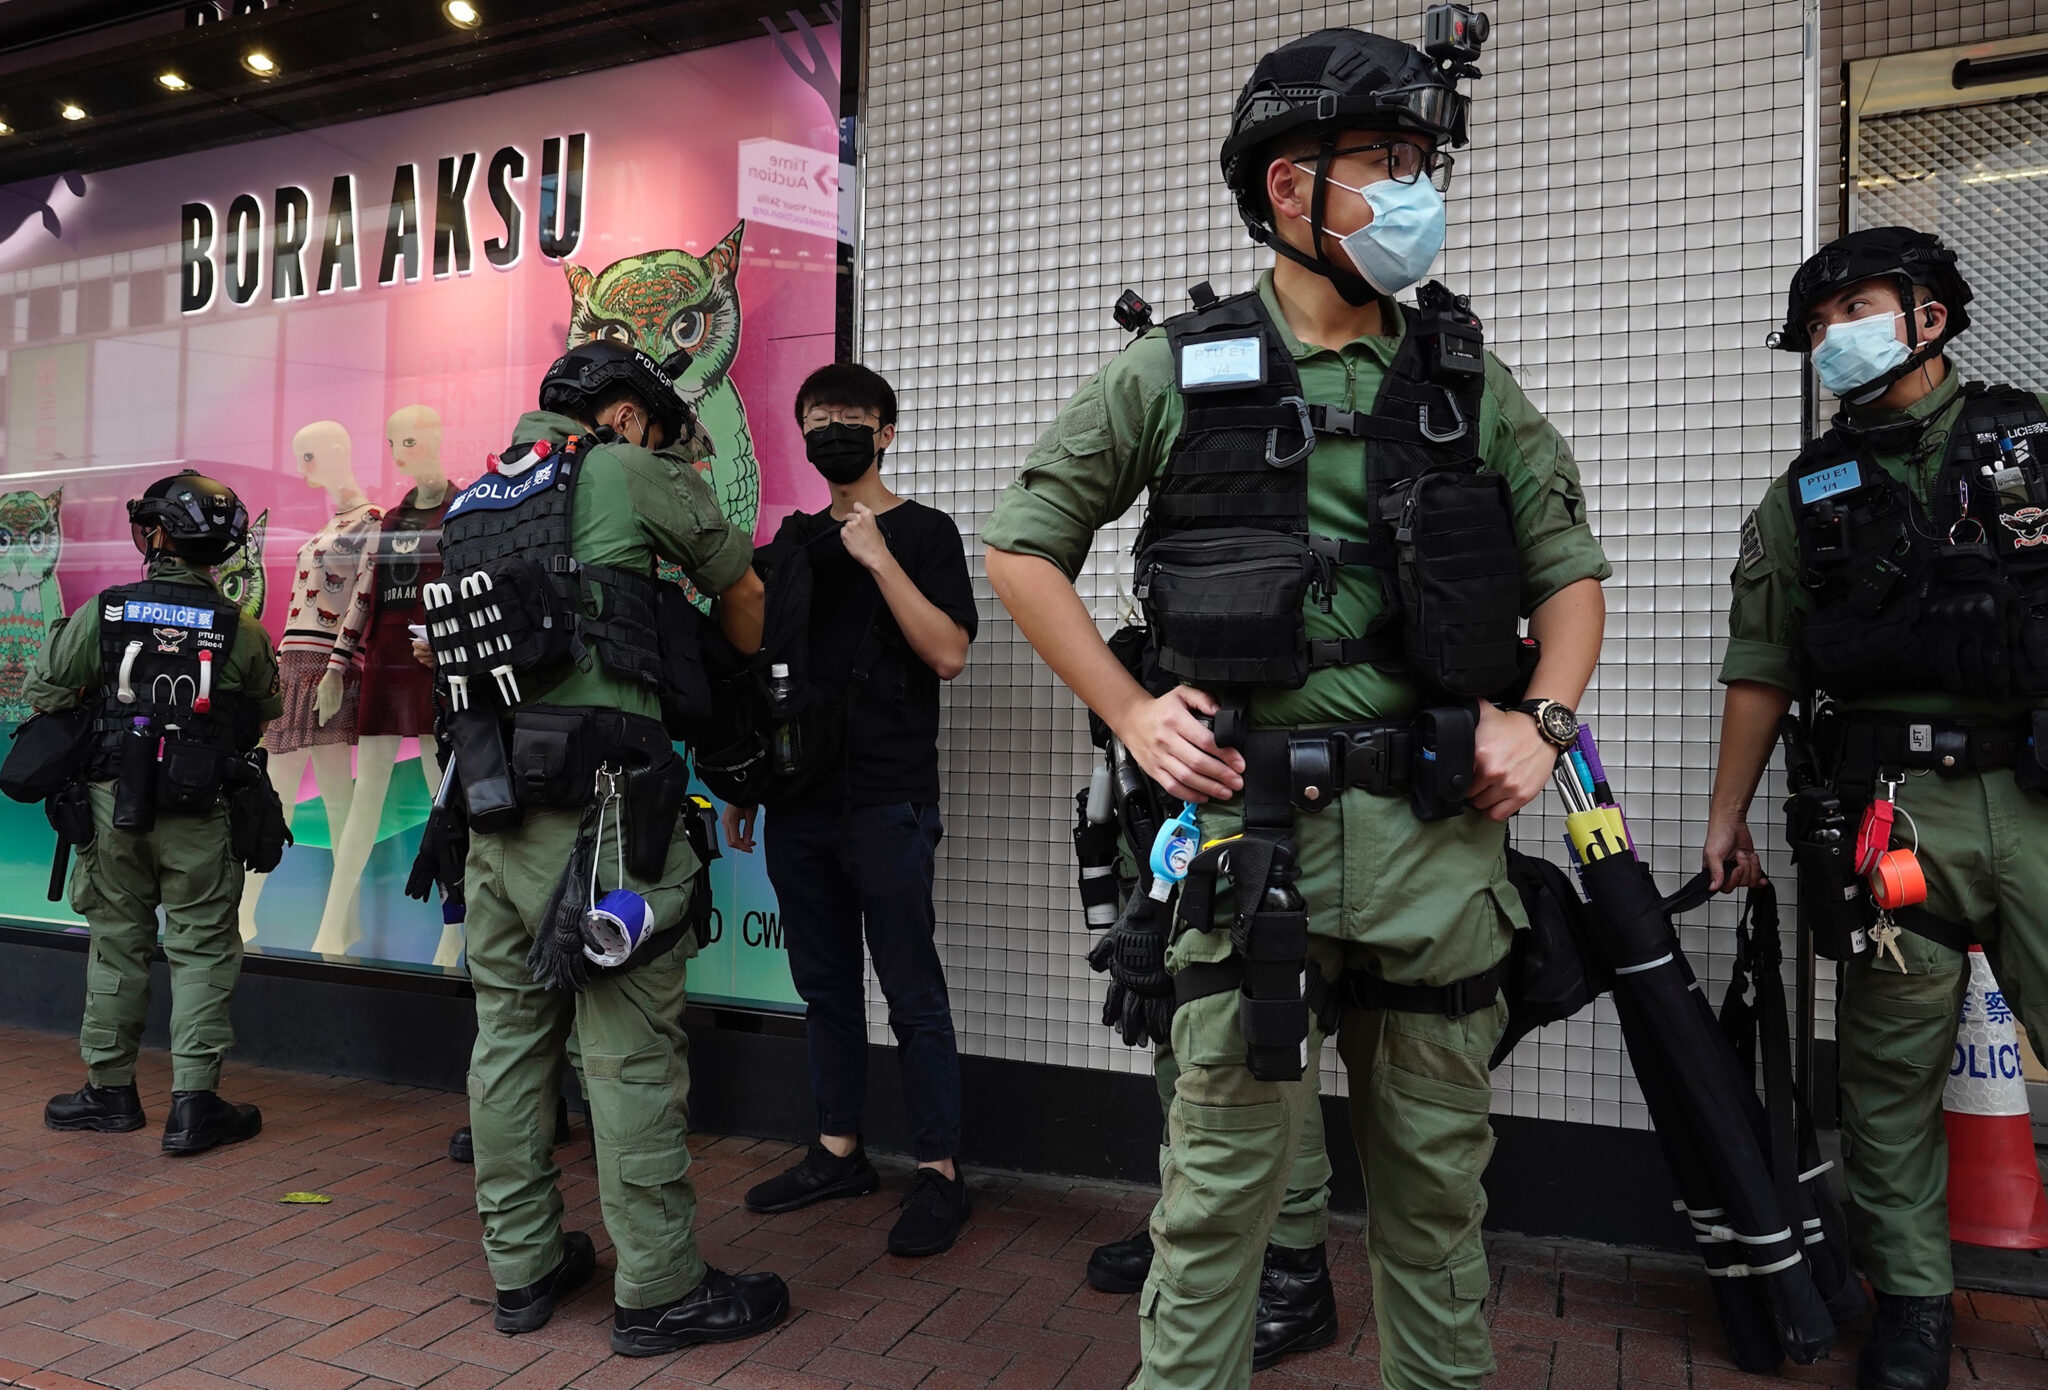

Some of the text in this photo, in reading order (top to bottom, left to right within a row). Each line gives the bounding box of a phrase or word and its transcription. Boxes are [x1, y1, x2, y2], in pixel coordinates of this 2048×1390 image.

[181, 133, 588, 315] BORA AKSU
[1194, 347, 1246, 361] PTU E1
[1807, 467, 1848, 486] PTU E1
[465, 476, 534, 502] POLICE
[1821, 482, 1837, 492] 1/1
[142, 606, 195, 624] POLICE
[198, 613, 211, 626] 察
[198, 631, 214, 640] PTU
[1913, 729, 1922, 748] JFT
